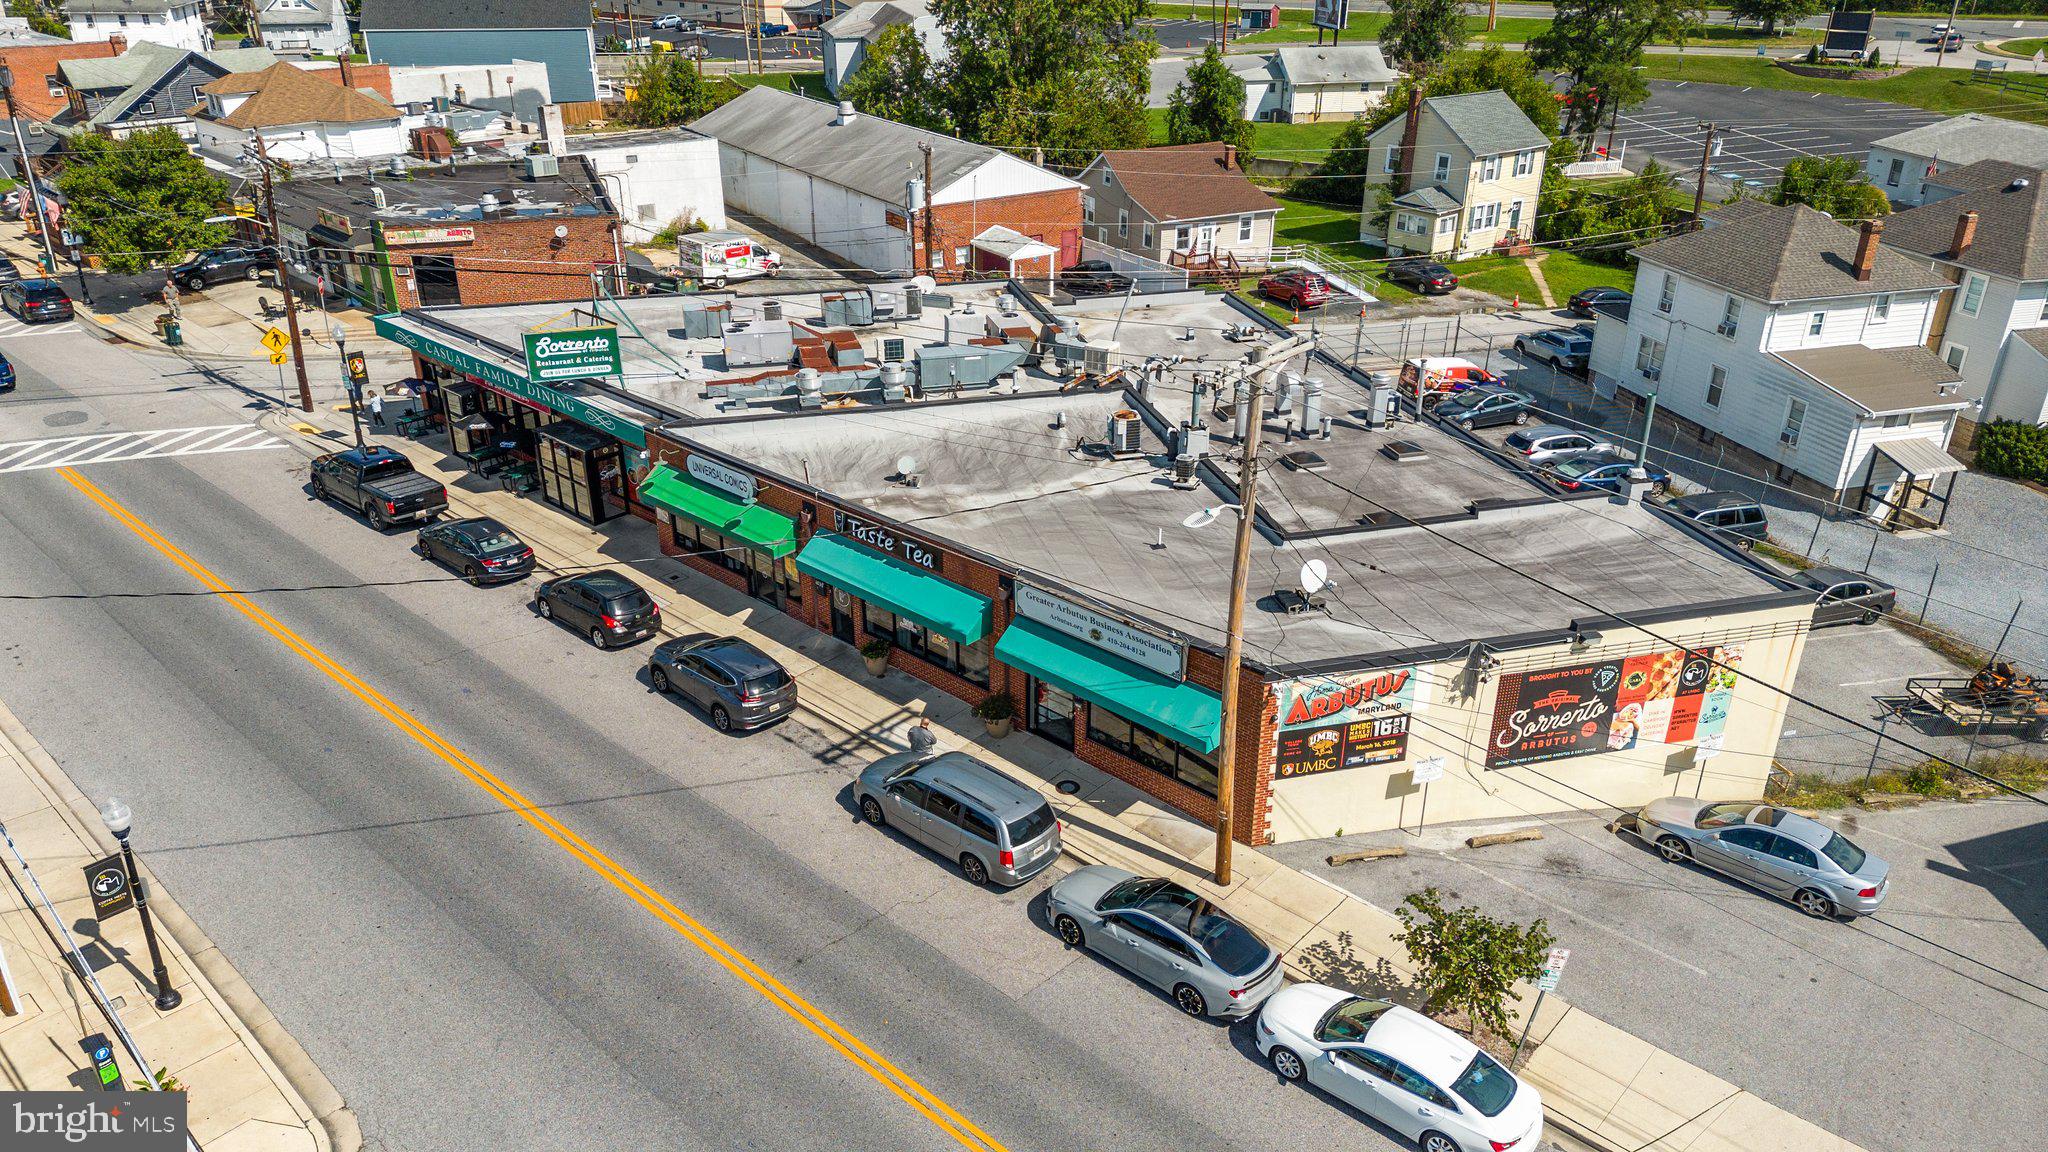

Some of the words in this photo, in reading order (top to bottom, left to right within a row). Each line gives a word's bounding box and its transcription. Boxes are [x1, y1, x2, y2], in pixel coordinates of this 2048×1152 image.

[536, 337, 609, 358] Sorrento
[536, 358, 575, 367] Restaurant
[576, 356, 582, 364] &
[584, 355, 613, 363] Catering
[425, 342, 470, 369] CASUAL
[475, 362, 520, 390] FAMILY
[527, 383, 574, 412] DINING
[692, 460, 724, 482] UNIVERSAL
[724, 474, 748, 493] COMICS
[847, 519, 894, 551] Taste
[901, 540, 933, 569] Tea
[1025, 591, 1055, 609] Greater
[1055, 603, 1088, 622] Arbutus
[1089, 616, 1124, 637] Business
[1124, 631, 1172, 657] Association
[1049, 613, 1084, 633] Arbutus.org
[1107, 636, 1146, 657] 410-204-8128
[1528, 672, 1560, 682] BROUGHT
[1571, 669, 1584, 677] YOU
[1284, 670, 1411, 726] ARBUTUS
[1358, 702, 1402, 715] MARYLAND
[1350, 722, 1371, 732] UMBC
[1374, 718, 1393, 737] 16
[1497, 695, 1609, 748] Sorrento
[1310, 731, 1339, 745] UMBC
[1355, 743, 1374, 751] March
[1521, 735, 1577, 751] ARBUTUS
[1295, 757, 1337, 774] UMBC
